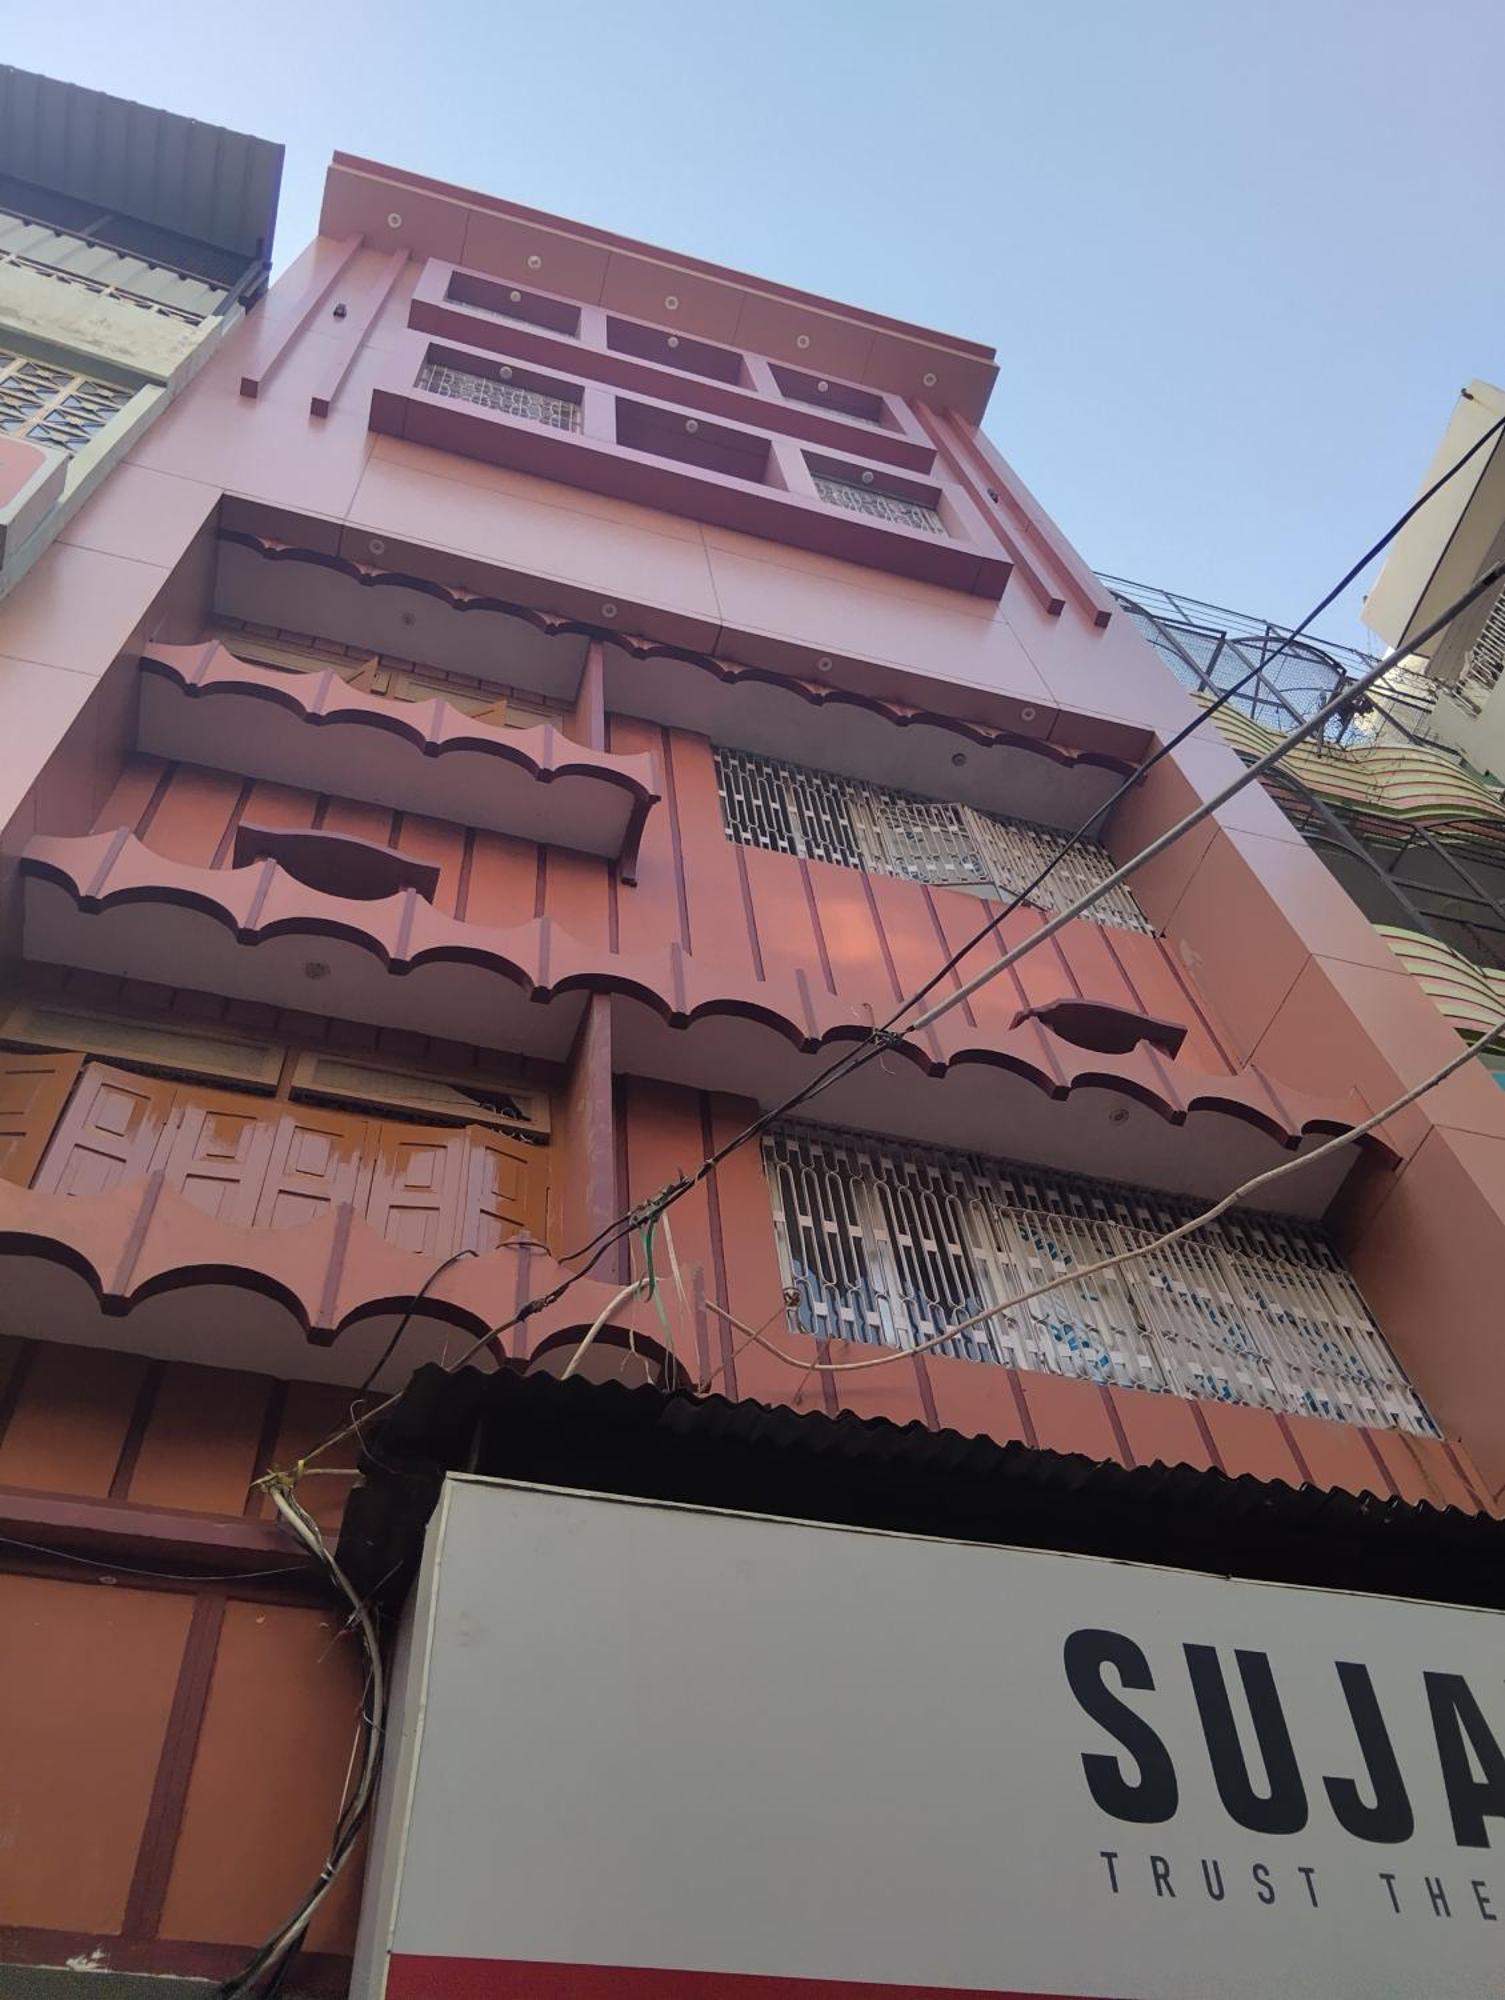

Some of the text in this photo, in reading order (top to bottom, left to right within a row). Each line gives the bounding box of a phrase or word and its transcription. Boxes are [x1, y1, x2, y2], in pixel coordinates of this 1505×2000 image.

[1064, 1629, 1505, 1849] SUJA
[1100, 1851, 1498, 1921] TRUST THE
